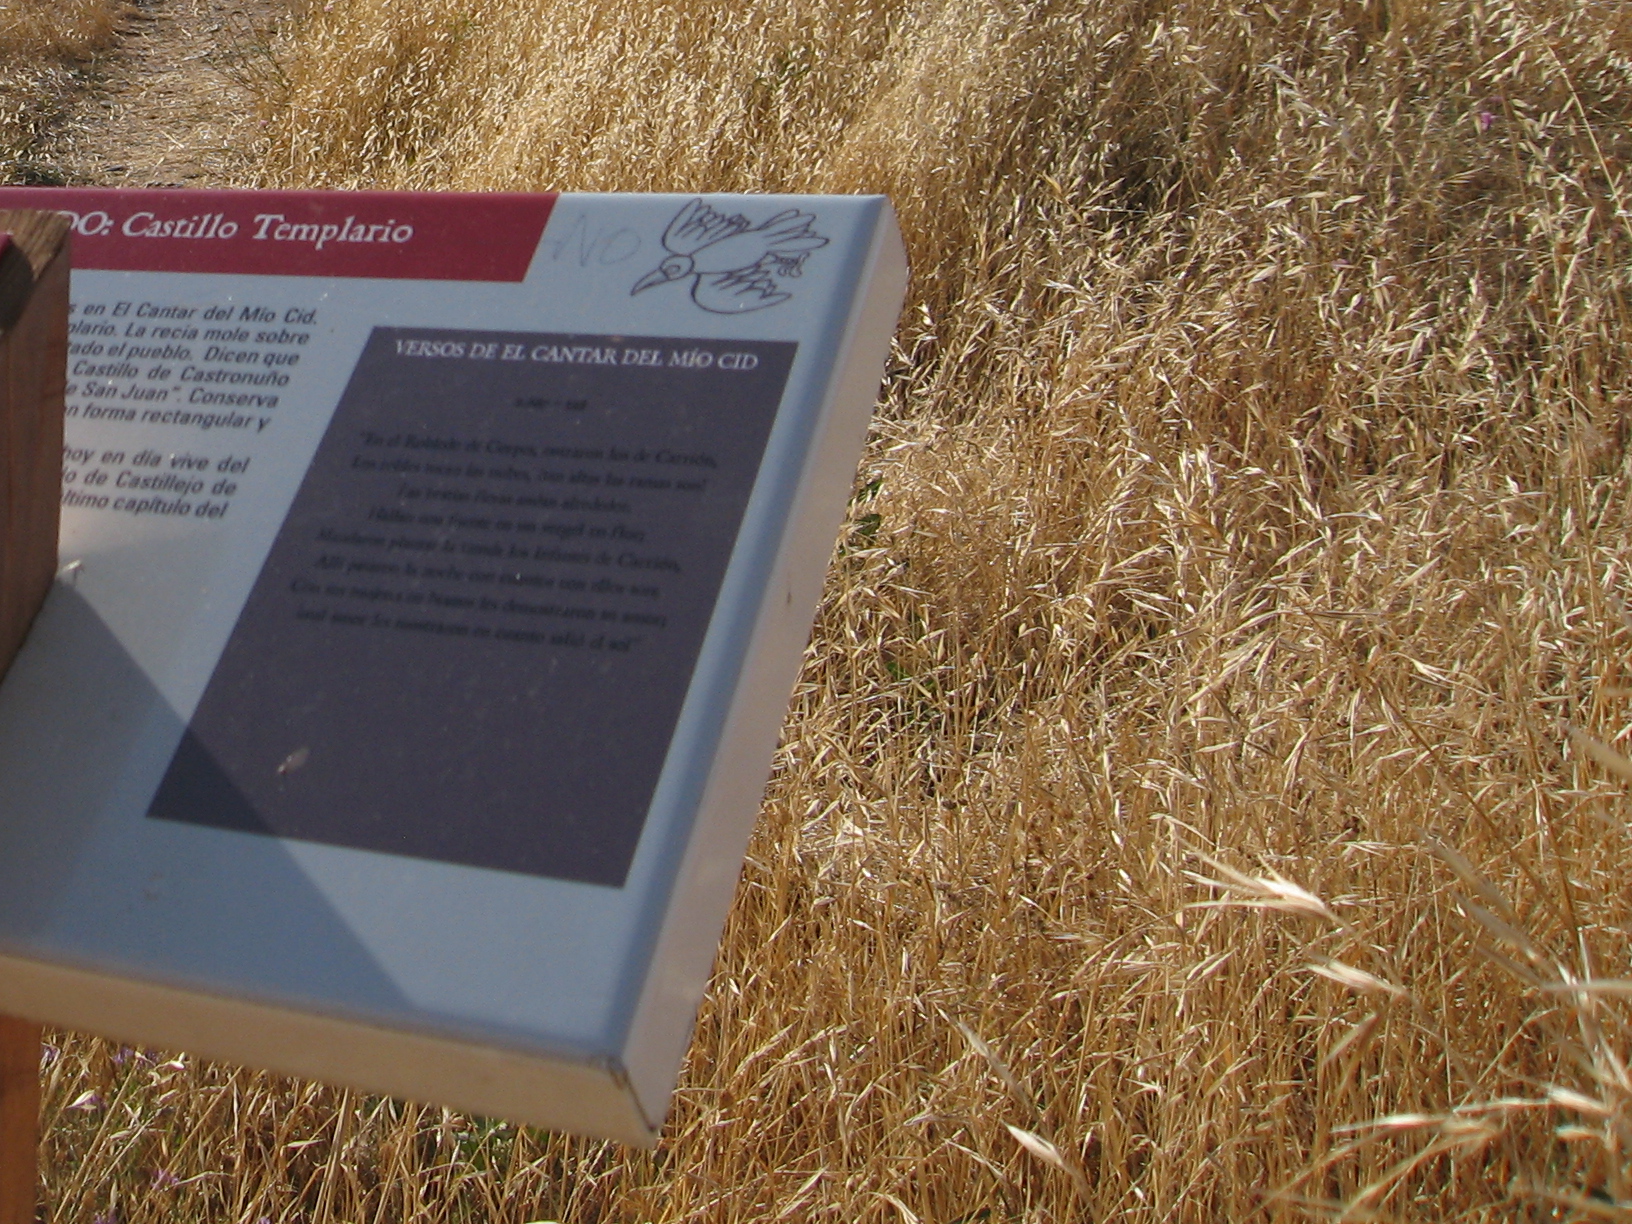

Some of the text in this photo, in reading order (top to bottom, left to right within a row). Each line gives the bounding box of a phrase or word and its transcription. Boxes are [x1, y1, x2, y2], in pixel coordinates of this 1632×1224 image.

[122, 211, 238, 239] Castillo
[251, 213, 413, 250] Templario
[83, 304, 105, 316] en
[112, 302, 131, 317] El
[136, 303, 196, 321] Cantar
[203, 306, 234, 321] del
[284, 308, 317, 325] Cid.
[125, 322, 146, 338] La
[151, 325, 197, 340] recia
[203, 327, 249, 343] mole
[255, 329, 310, 345] sobre
[108, 342, 127, 357] el
[126, 344, 194, 363] pueblo.
[204, 346, 259, 365] Dicen
[263, 351, 300, 368] que
[395, 339, 465, 358] VERSOS
[468, 342, 499, 359] DE
[501, 344, 526, 361] EL
[530, 345, 618, 365] CANTAR
[621, 348, 663, 366] DEL
[718, 352, 759, 370] CID
[73, 360, 290, 387] Castillo de Castronuño
[81, 382, 118, 398] San
[188, 387, 280, 407] Conserva
[82, 402, 137, 422] forma
[141, 408, 255, 432] rectangular
[257, 416, 272, 433] y
[101, 450, 126, 464] en
[170, 454, 210, 471] vive
[217, 456, 252, 474] del
[84, 468, 109, 485] de
[116, 470, 205, 495] Castillejo
[211, 478, 237, 496] de
[62, 489, 231, 520] ltimo capítulo del
